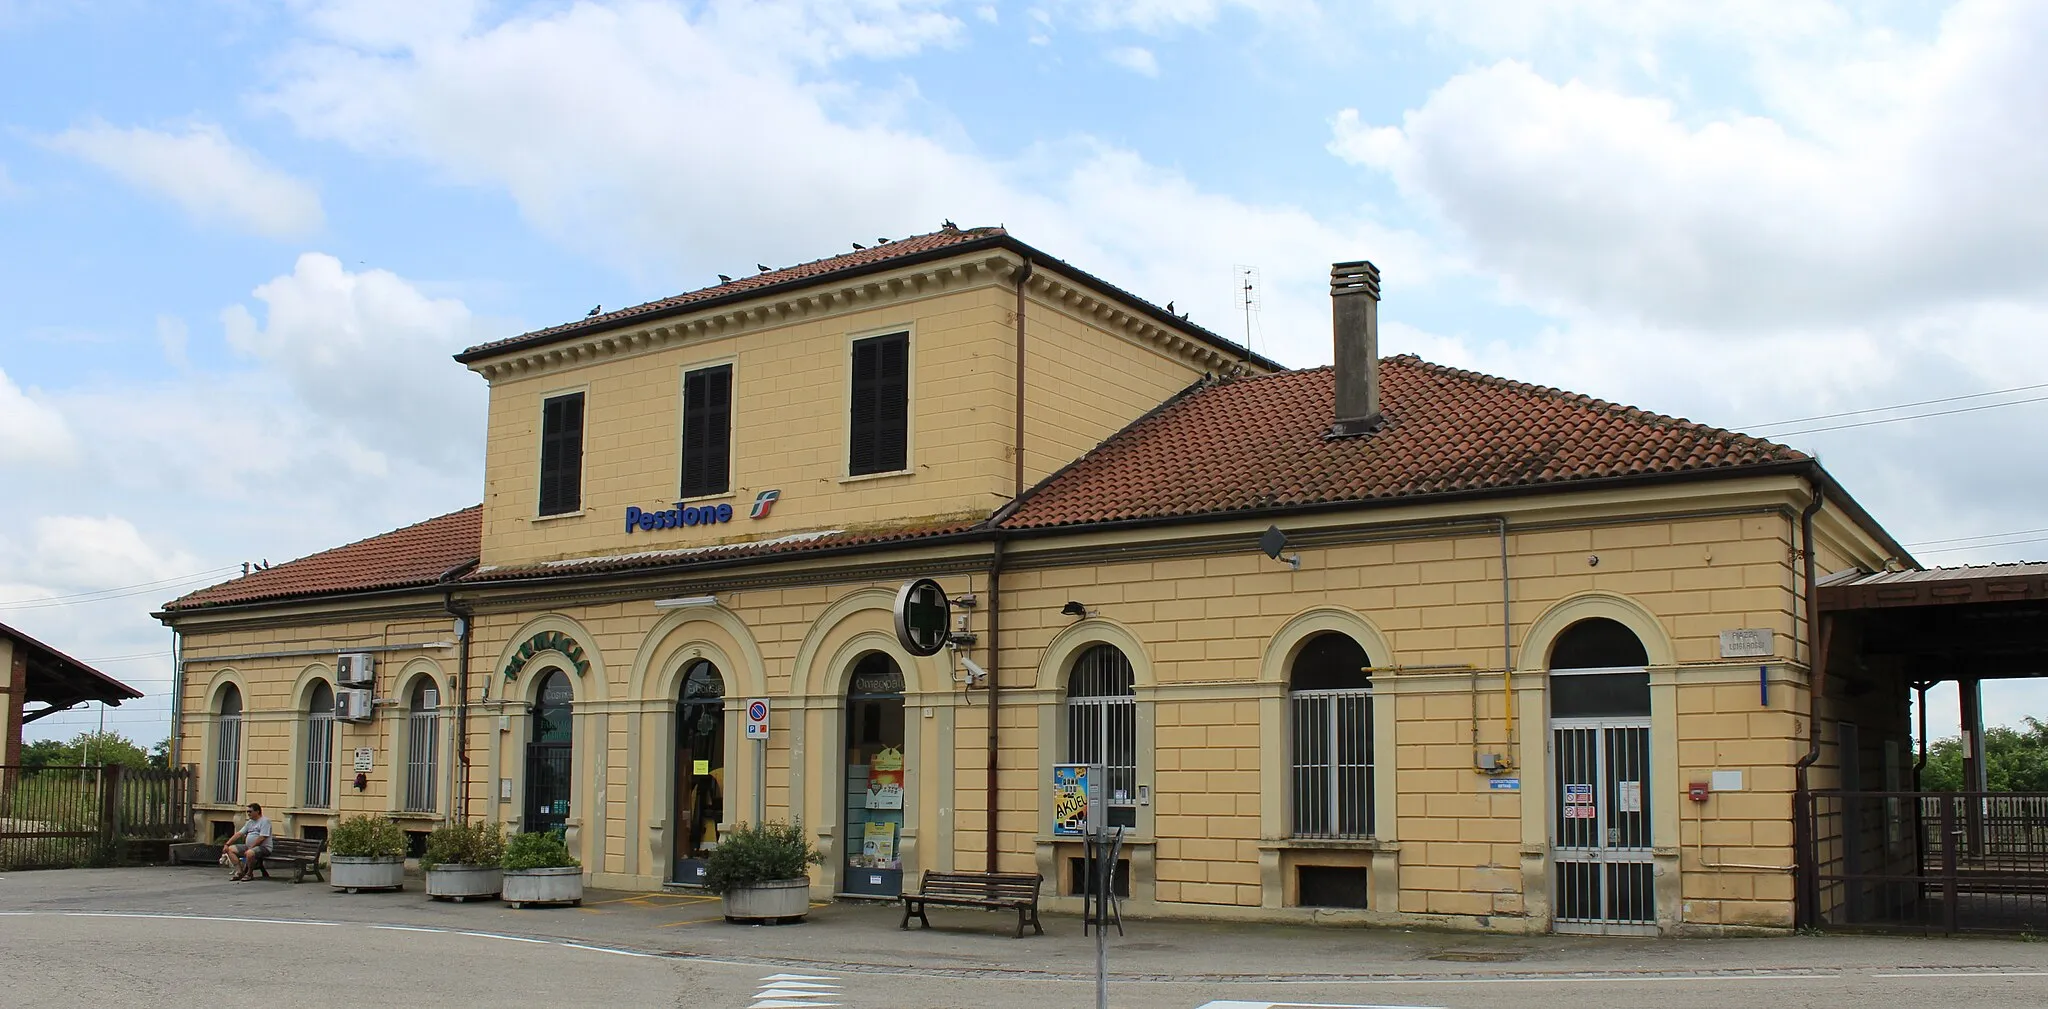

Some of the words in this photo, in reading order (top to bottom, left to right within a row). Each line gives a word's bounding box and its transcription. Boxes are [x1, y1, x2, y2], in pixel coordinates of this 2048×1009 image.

[625, 502, 733, 534] Pessione
[1732, 631, 1758, 639] PIAZZA
[504, 631, 590, 680] FARMACIA
[1056, 795, 1088, 819] AKUEL
